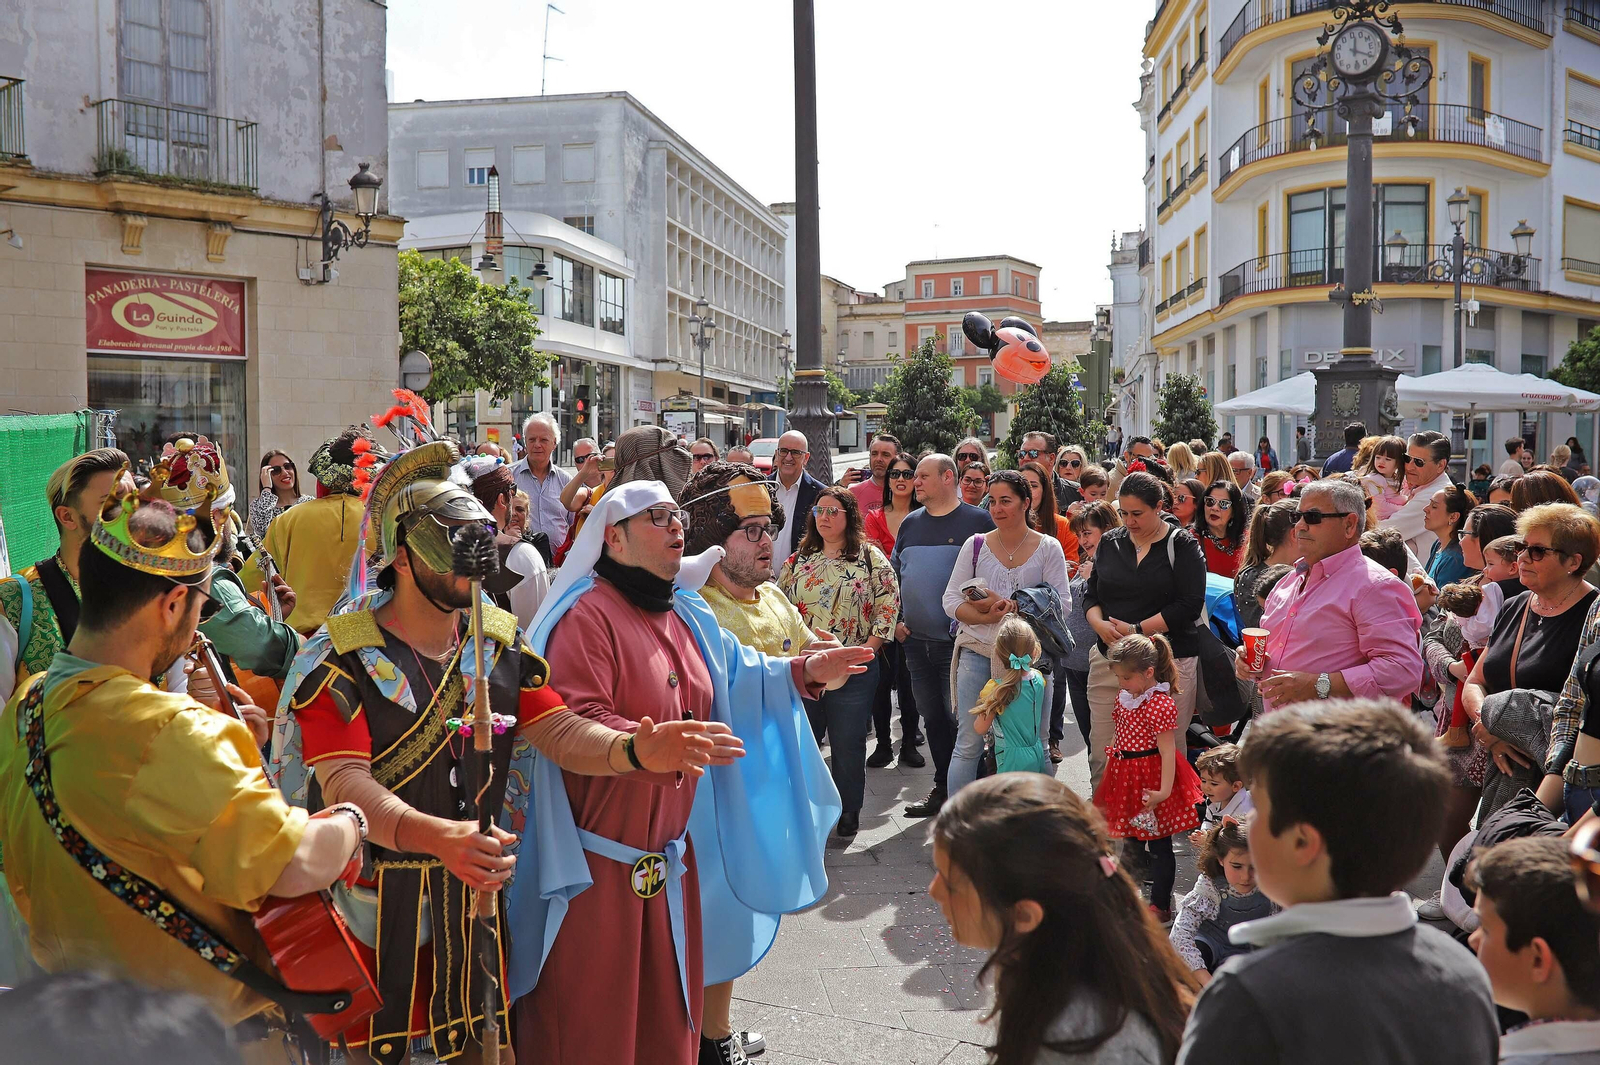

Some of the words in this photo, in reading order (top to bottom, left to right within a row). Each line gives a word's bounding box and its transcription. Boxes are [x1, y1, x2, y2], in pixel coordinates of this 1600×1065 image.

[87, 278, 160, 305] PANADERIA
[170, 279, 240, 315] PASTELERIA
[133, 310, 151, 321] La
[157, 312, 203, 324] Guinda
[98, 339, 141, 348] Elaboración
[141, 342, 174, 351] artesanal
[174, 343, 196, 351] propia
[197, 343, 216, 352] desde
[1304, 348, 1405, 363] DEIX
[1521, 392, 1562, 401] Cruzcampo
